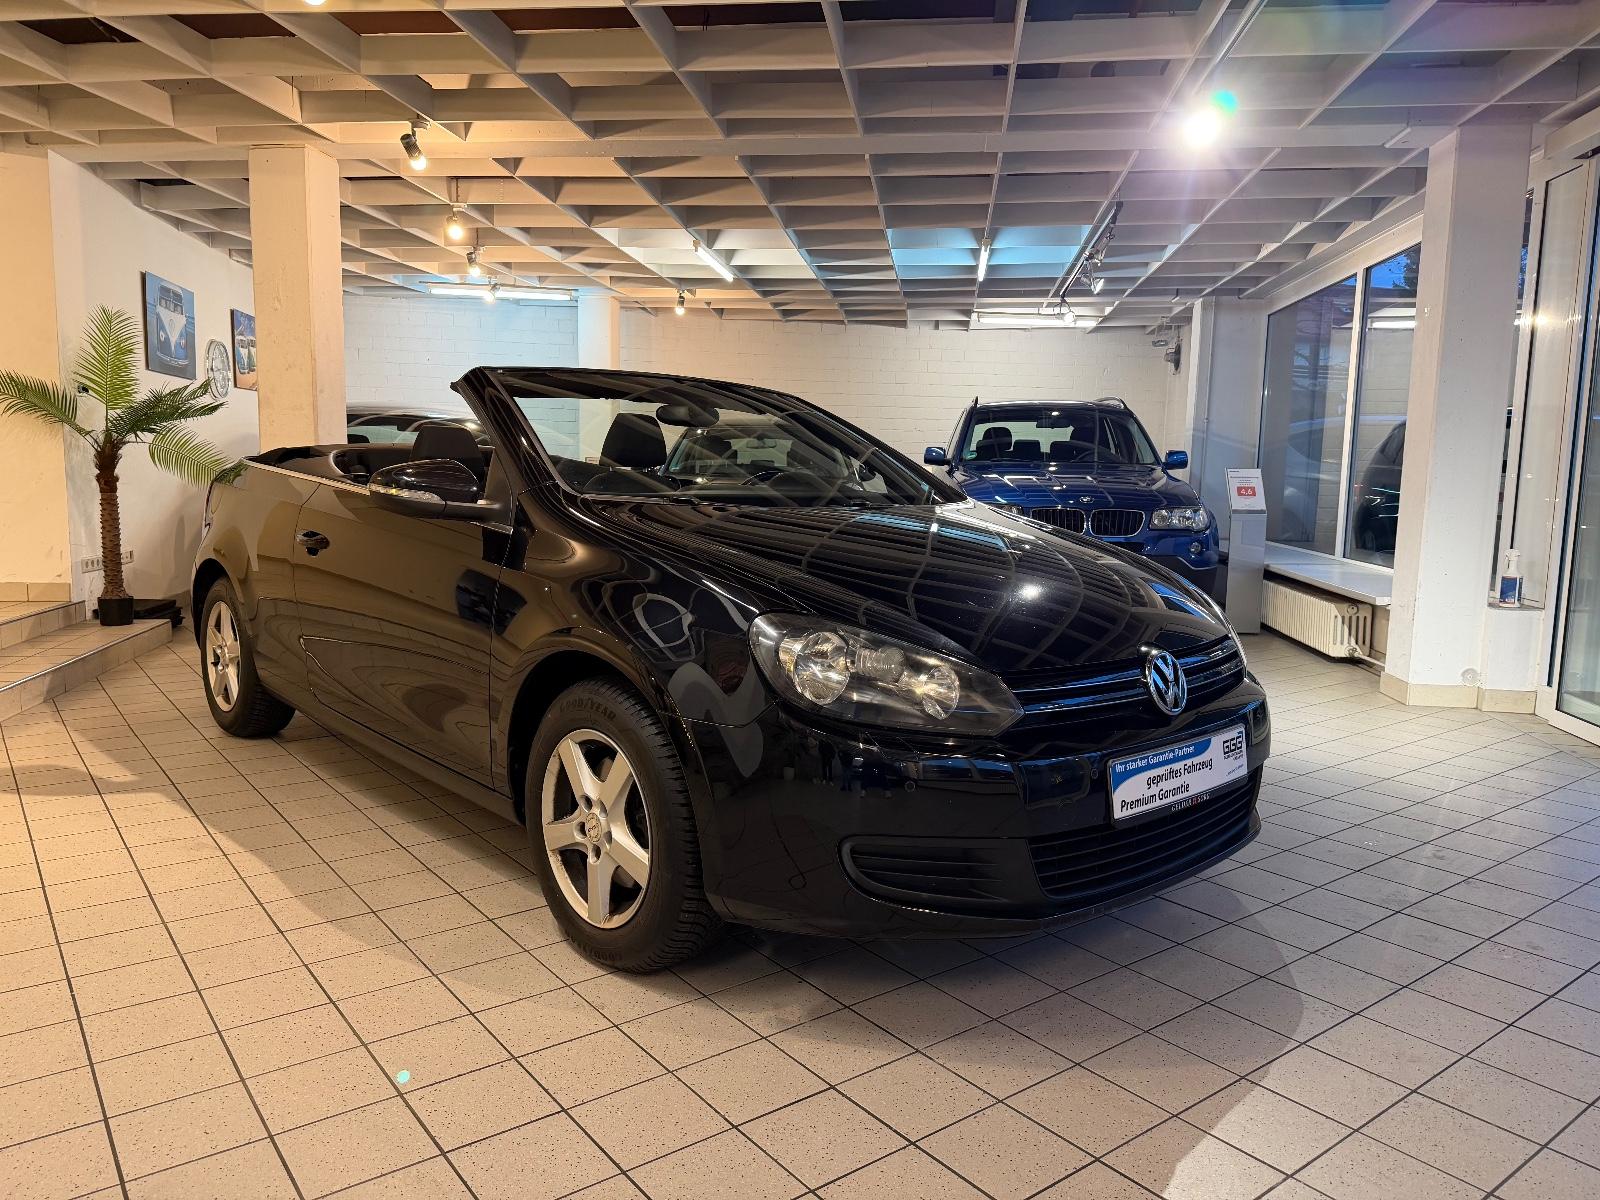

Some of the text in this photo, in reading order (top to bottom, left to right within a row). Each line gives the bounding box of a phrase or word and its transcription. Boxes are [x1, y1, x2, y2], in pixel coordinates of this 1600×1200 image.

[1115, 745, 1195, 773] Ihr starker Garantie-Partner
[1146, 766, 1182, 790] geprüftes
[1183, 758, 1213, 776] Fahrzeug
[1120, 794, 1157, 813] Premium
[1158, 783, 1190, 802] Garantie
